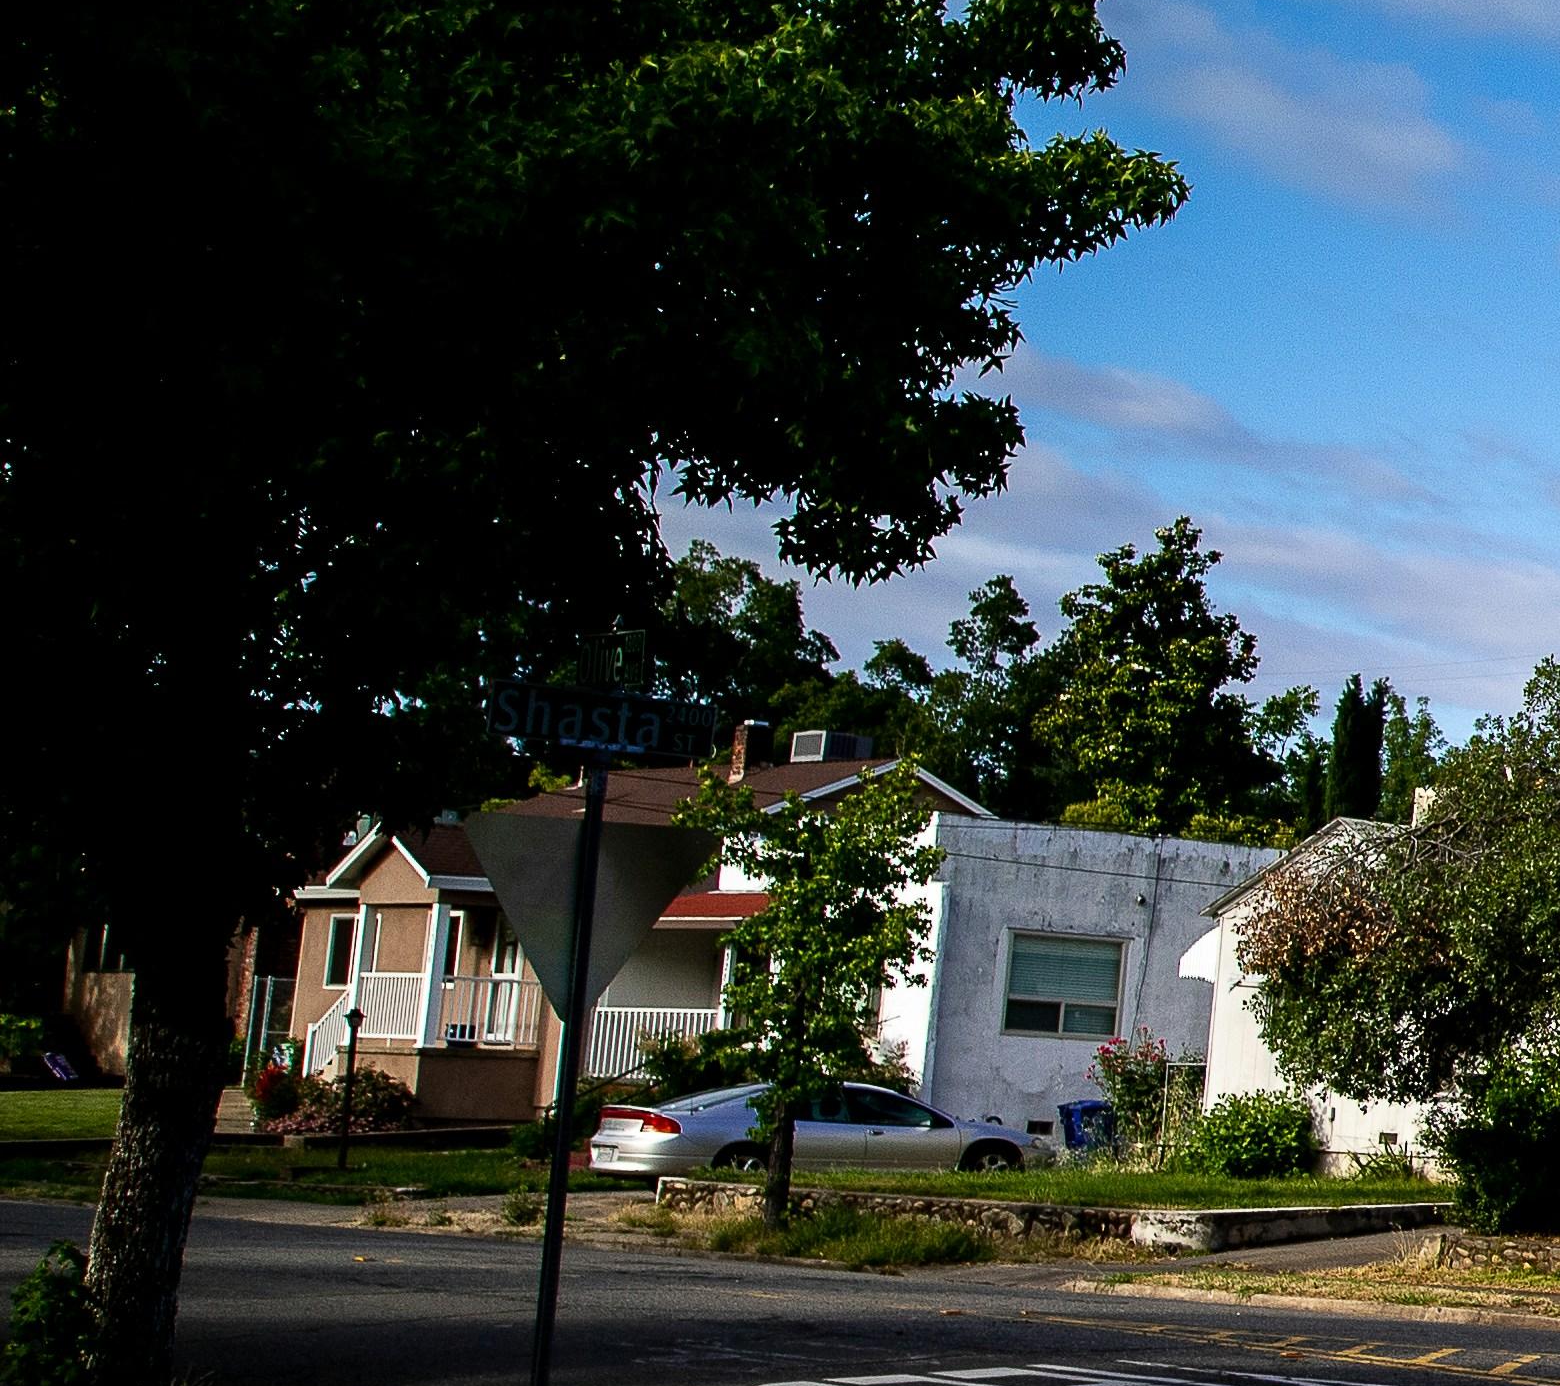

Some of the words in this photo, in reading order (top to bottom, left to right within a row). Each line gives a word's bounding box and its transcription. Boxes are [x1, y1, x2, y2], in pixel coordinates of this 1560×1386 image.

[579, 637, 623, 683] Olive
[494, 687, 661, 748] Shasta
[672, 732, 697, 754] ST
[664, 704, 712, 727] 2400
